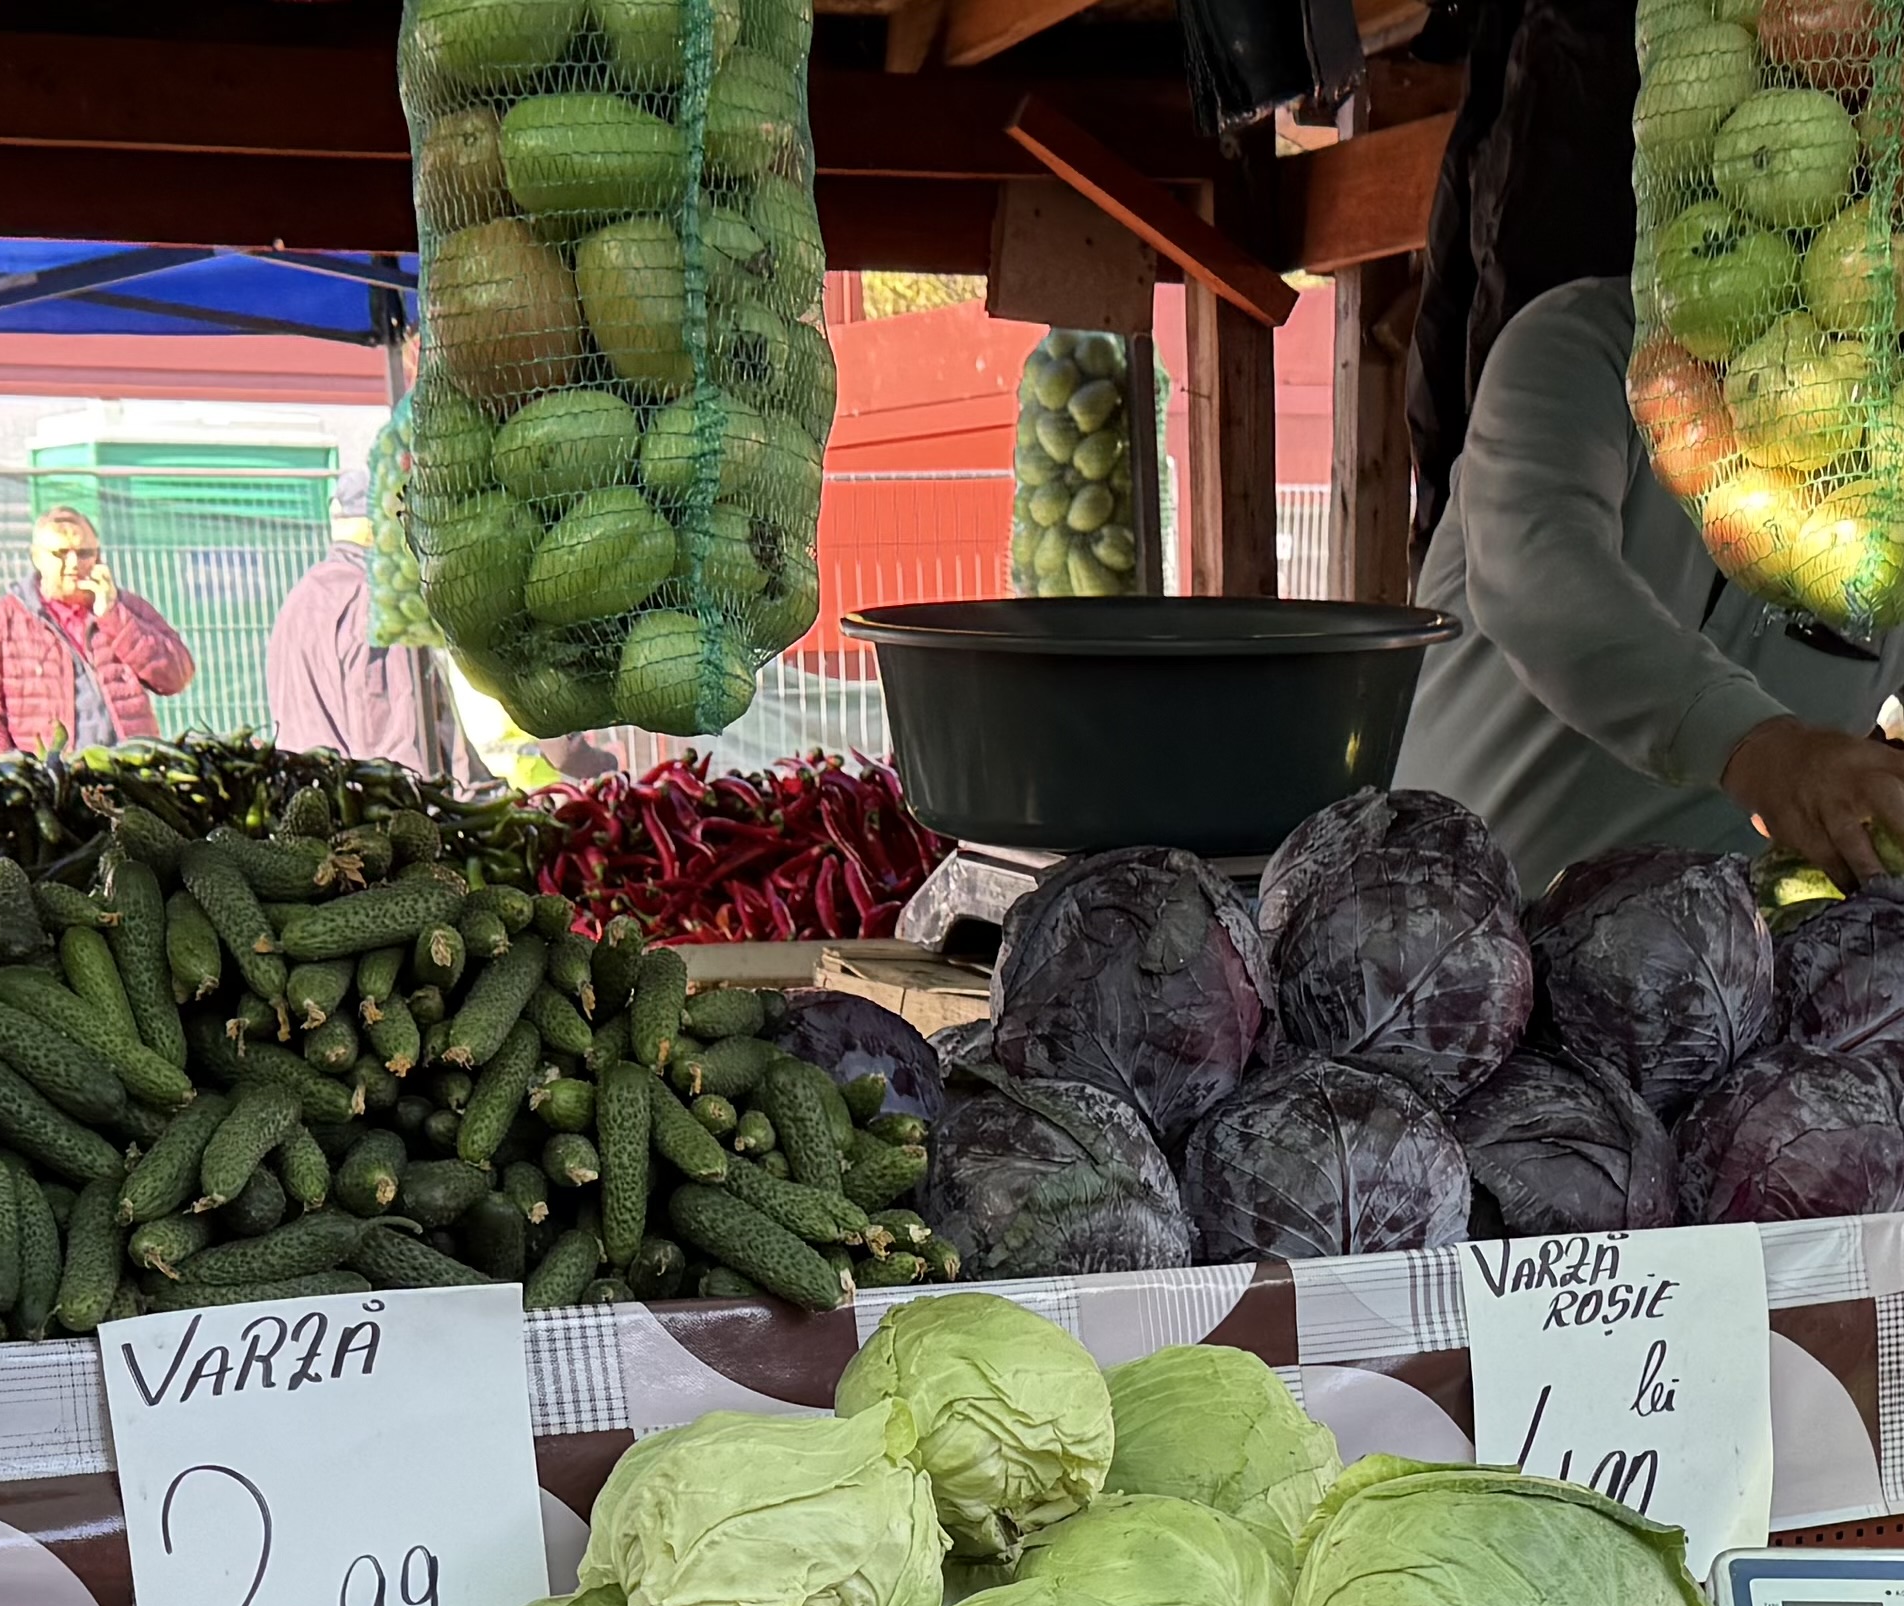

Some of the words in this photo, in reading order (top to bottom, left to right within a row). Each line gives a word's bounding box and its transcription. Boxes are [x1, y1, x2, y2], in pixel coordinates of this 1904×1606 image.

[1470, 1232, 1629, 1298] VARZĂ
[121, 1299, 386, 1406] VARZĂ
[1630, 1339, 1680, 1417] lei
